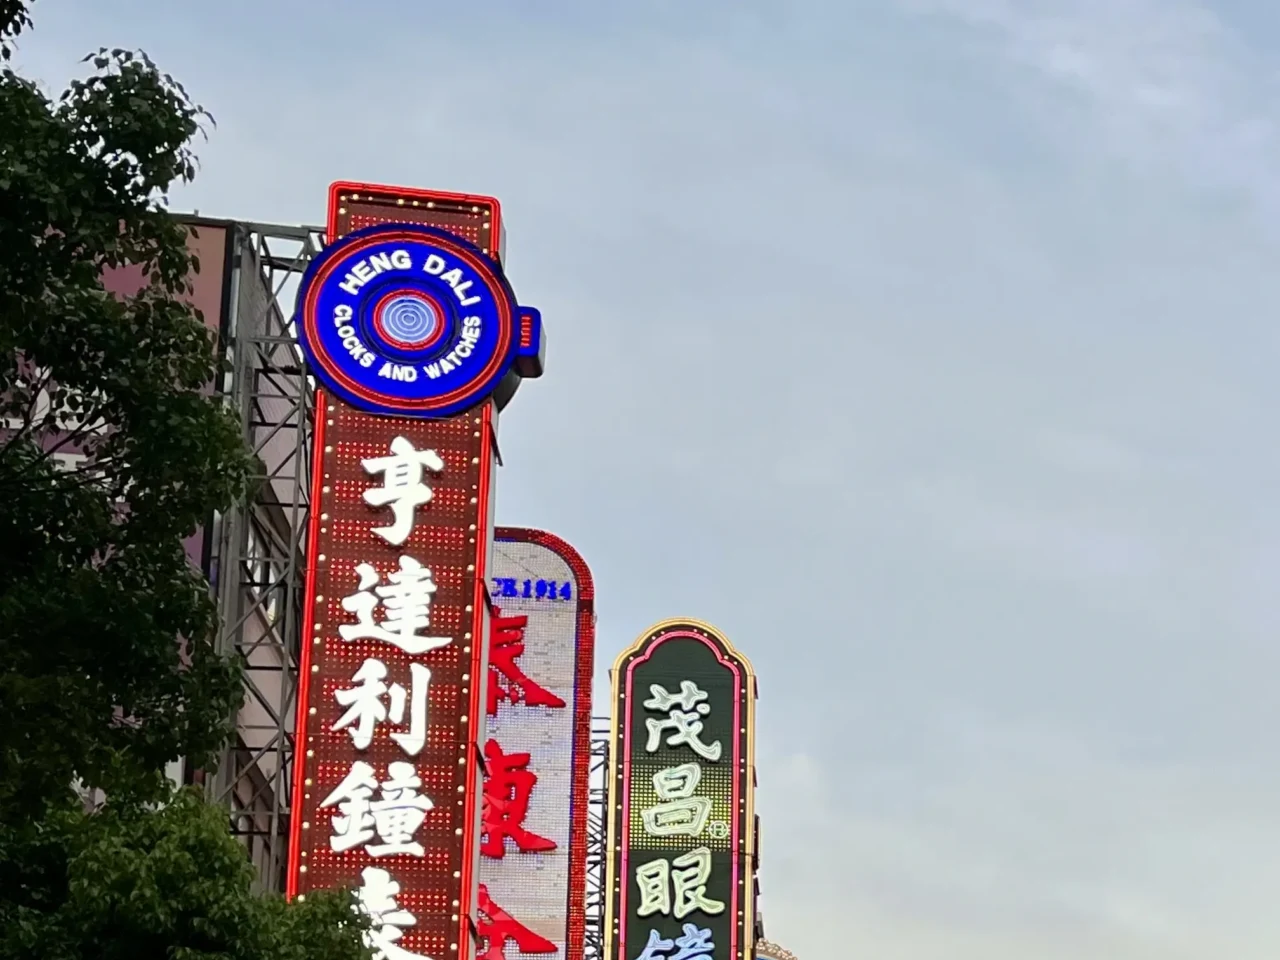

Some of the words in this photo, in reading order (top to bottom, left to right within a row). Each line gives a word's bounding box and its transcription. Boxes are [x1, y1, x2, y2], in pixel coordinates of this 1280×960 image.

[338, 250, 412, 296] HENG
[422, 253, 482, 307] DALI
[334, 304, 375, 369] CLOCKS
[378, 362, 418, 383] AND
[423, 316, 482, 380] WATCHES
[522, 579, 573, 601] 1914
